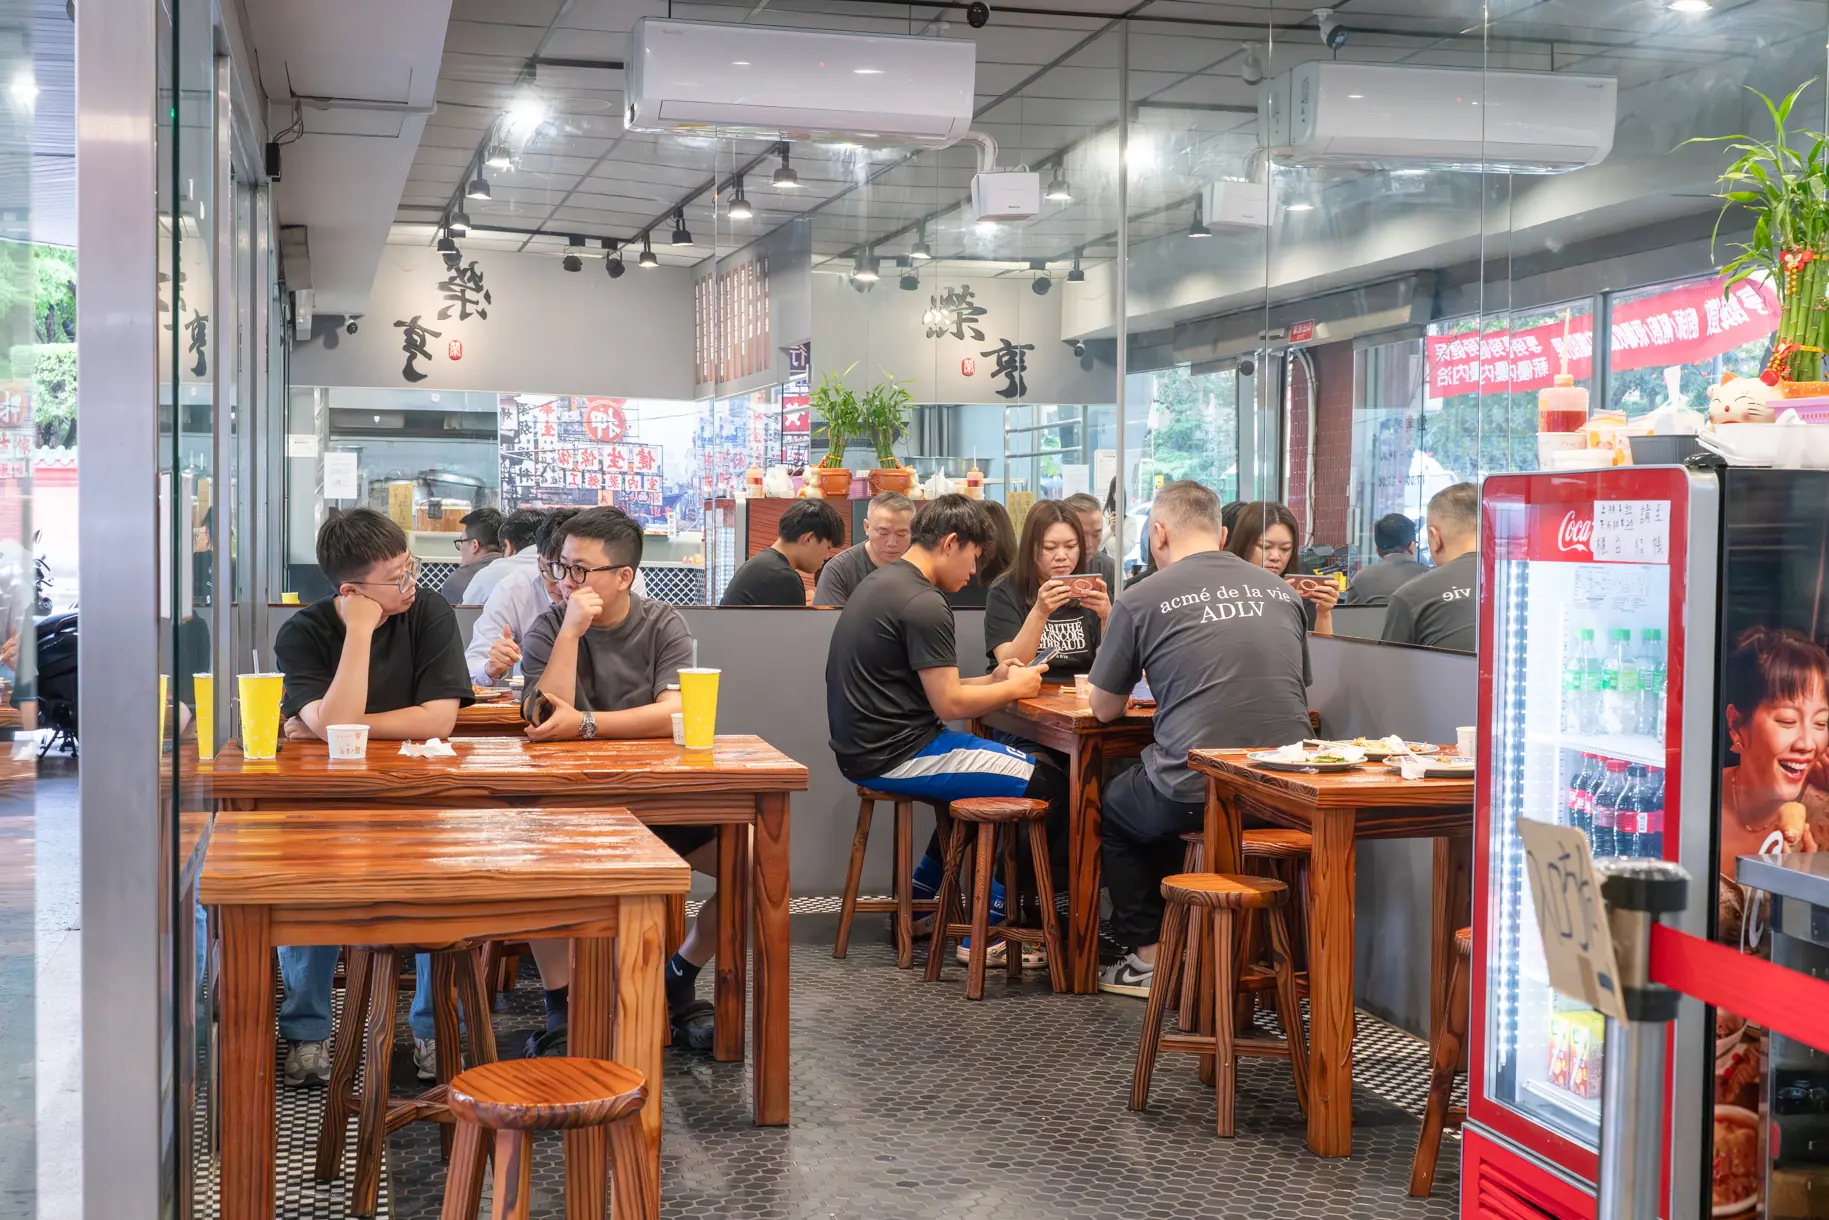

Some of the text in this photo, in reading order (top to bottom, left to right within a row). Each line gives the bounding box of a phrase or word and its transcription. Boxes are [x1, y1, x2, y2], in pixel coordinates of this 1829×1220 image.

[1159, 584, 1290, 614] acmé de la vie
[1200, 601, 1265, 624] ADLV
[1043, 620, 1083, 633] ARITHÉ
